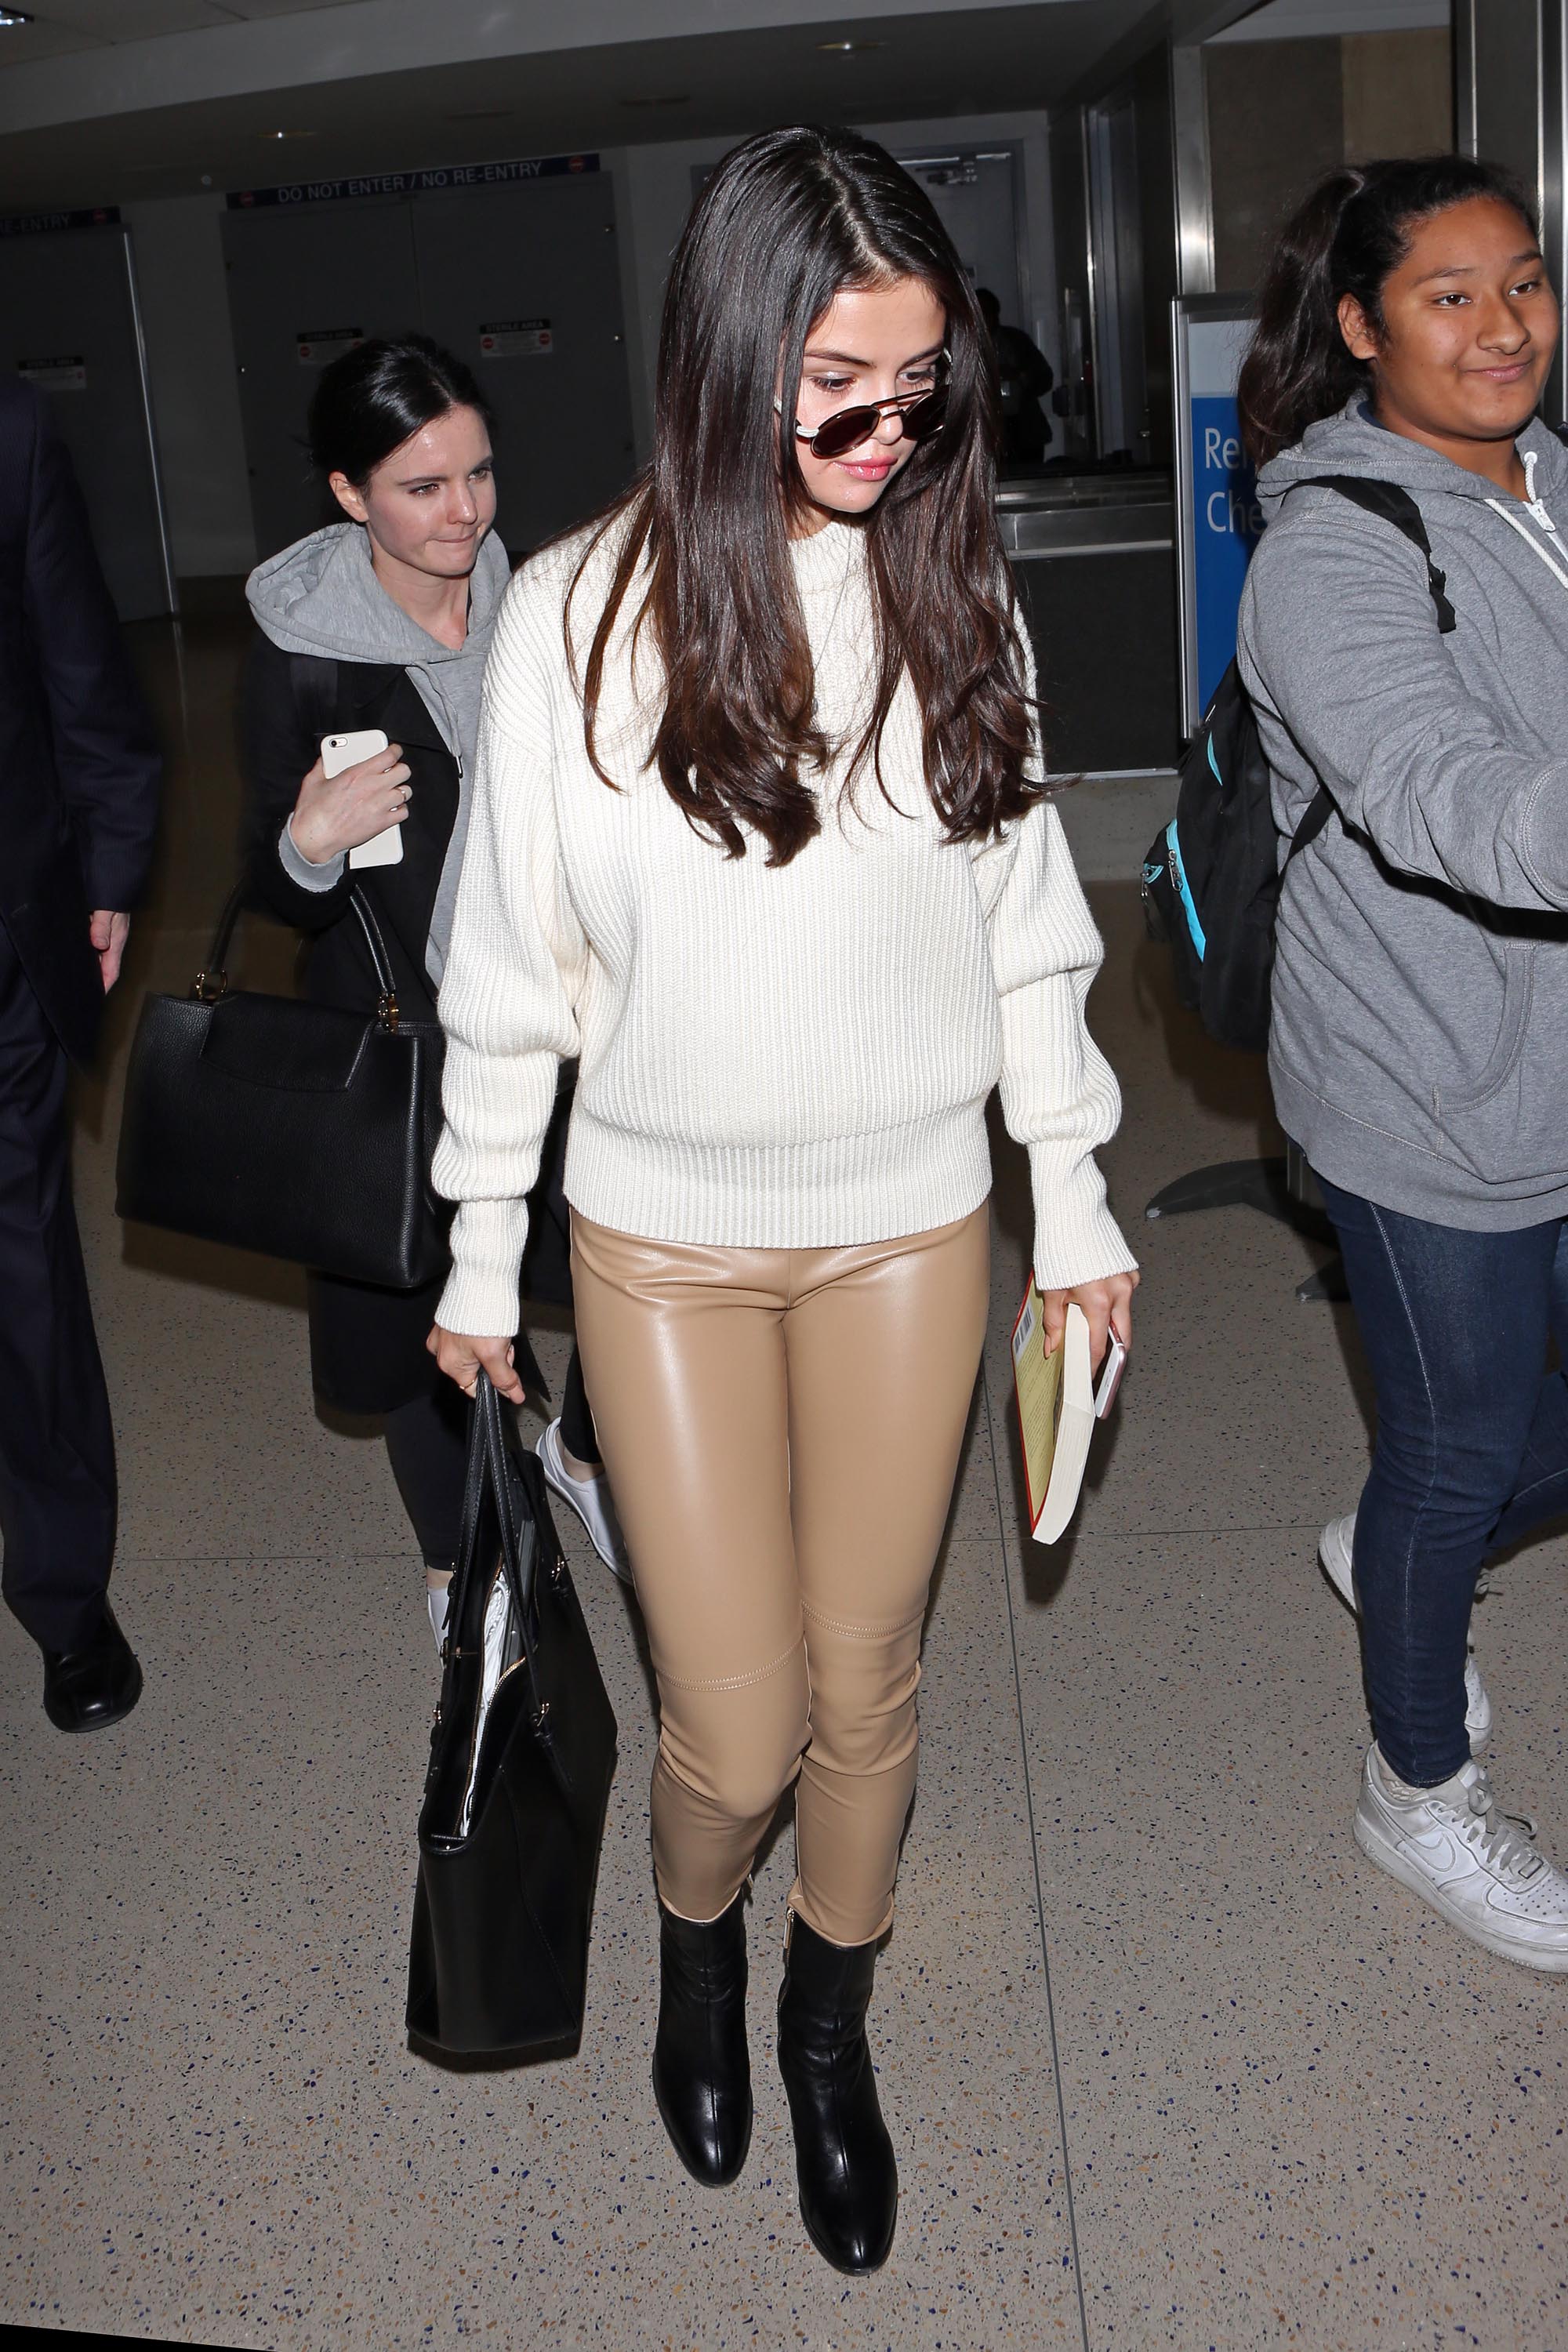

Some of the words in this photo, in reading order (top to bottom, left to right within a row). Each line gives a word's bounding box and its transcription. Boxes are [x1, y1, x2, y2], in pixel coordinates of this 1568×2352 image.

[278, 188, 302, 202] DO
[307, 182, 343, 199] NOT
[348, 176, 405, 195] ENTER
[422, 172, 448, 187] NO
[453, 161, 543, 185] RE-ENTRY
